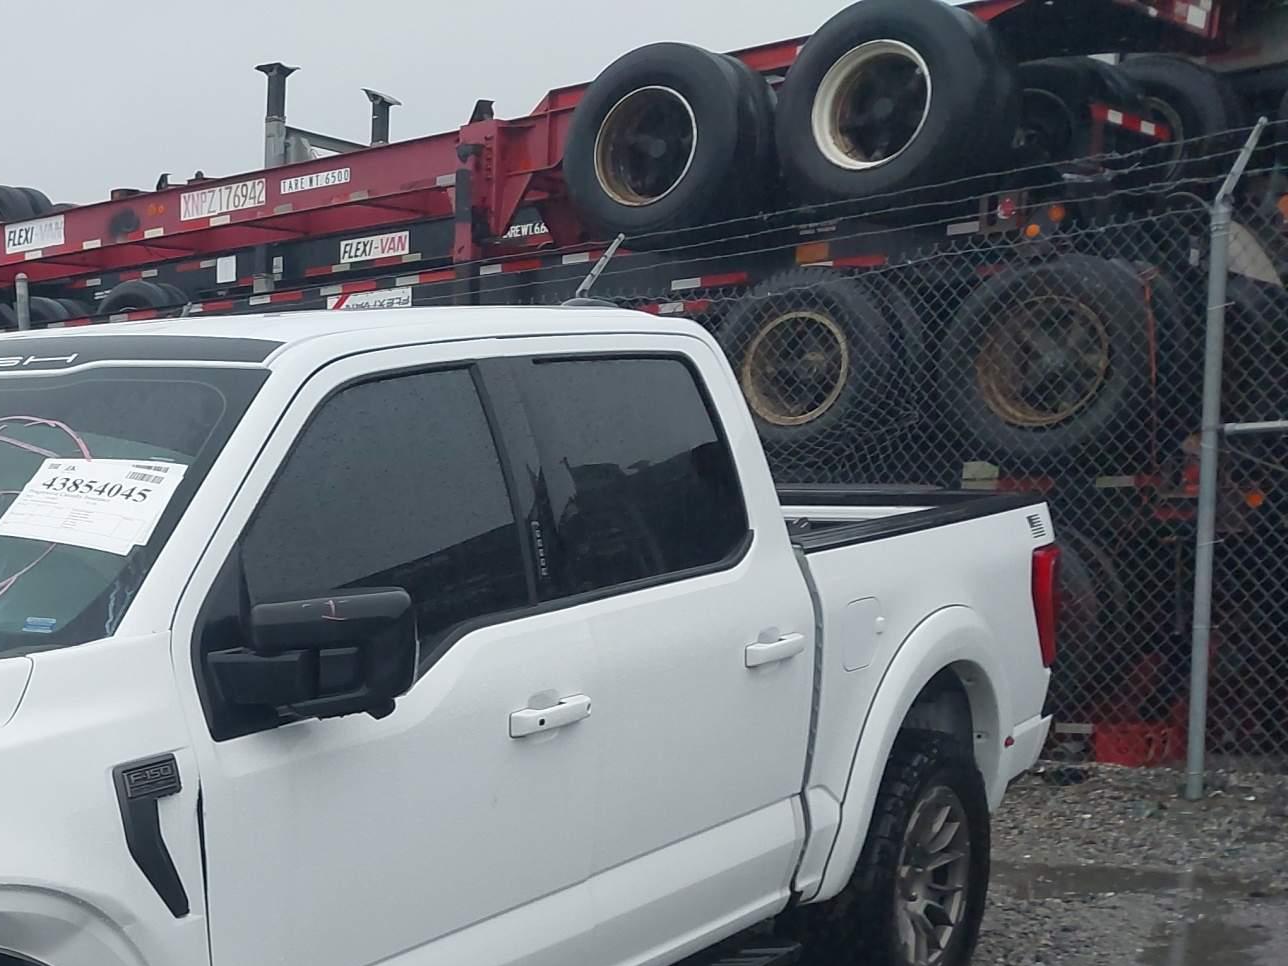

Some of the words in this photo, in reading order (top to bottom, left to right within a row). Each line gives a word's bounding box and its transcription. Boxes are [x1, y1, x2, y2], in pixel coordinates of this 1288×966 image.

[282, 177, 305, 193] TARE
[325, 168, 349, 185] 6500
[342, 235, 407, 259] FLEXI-VAN
[42, 476, 153, 503] 43854045
[130, 765, 172, 784] F-150
